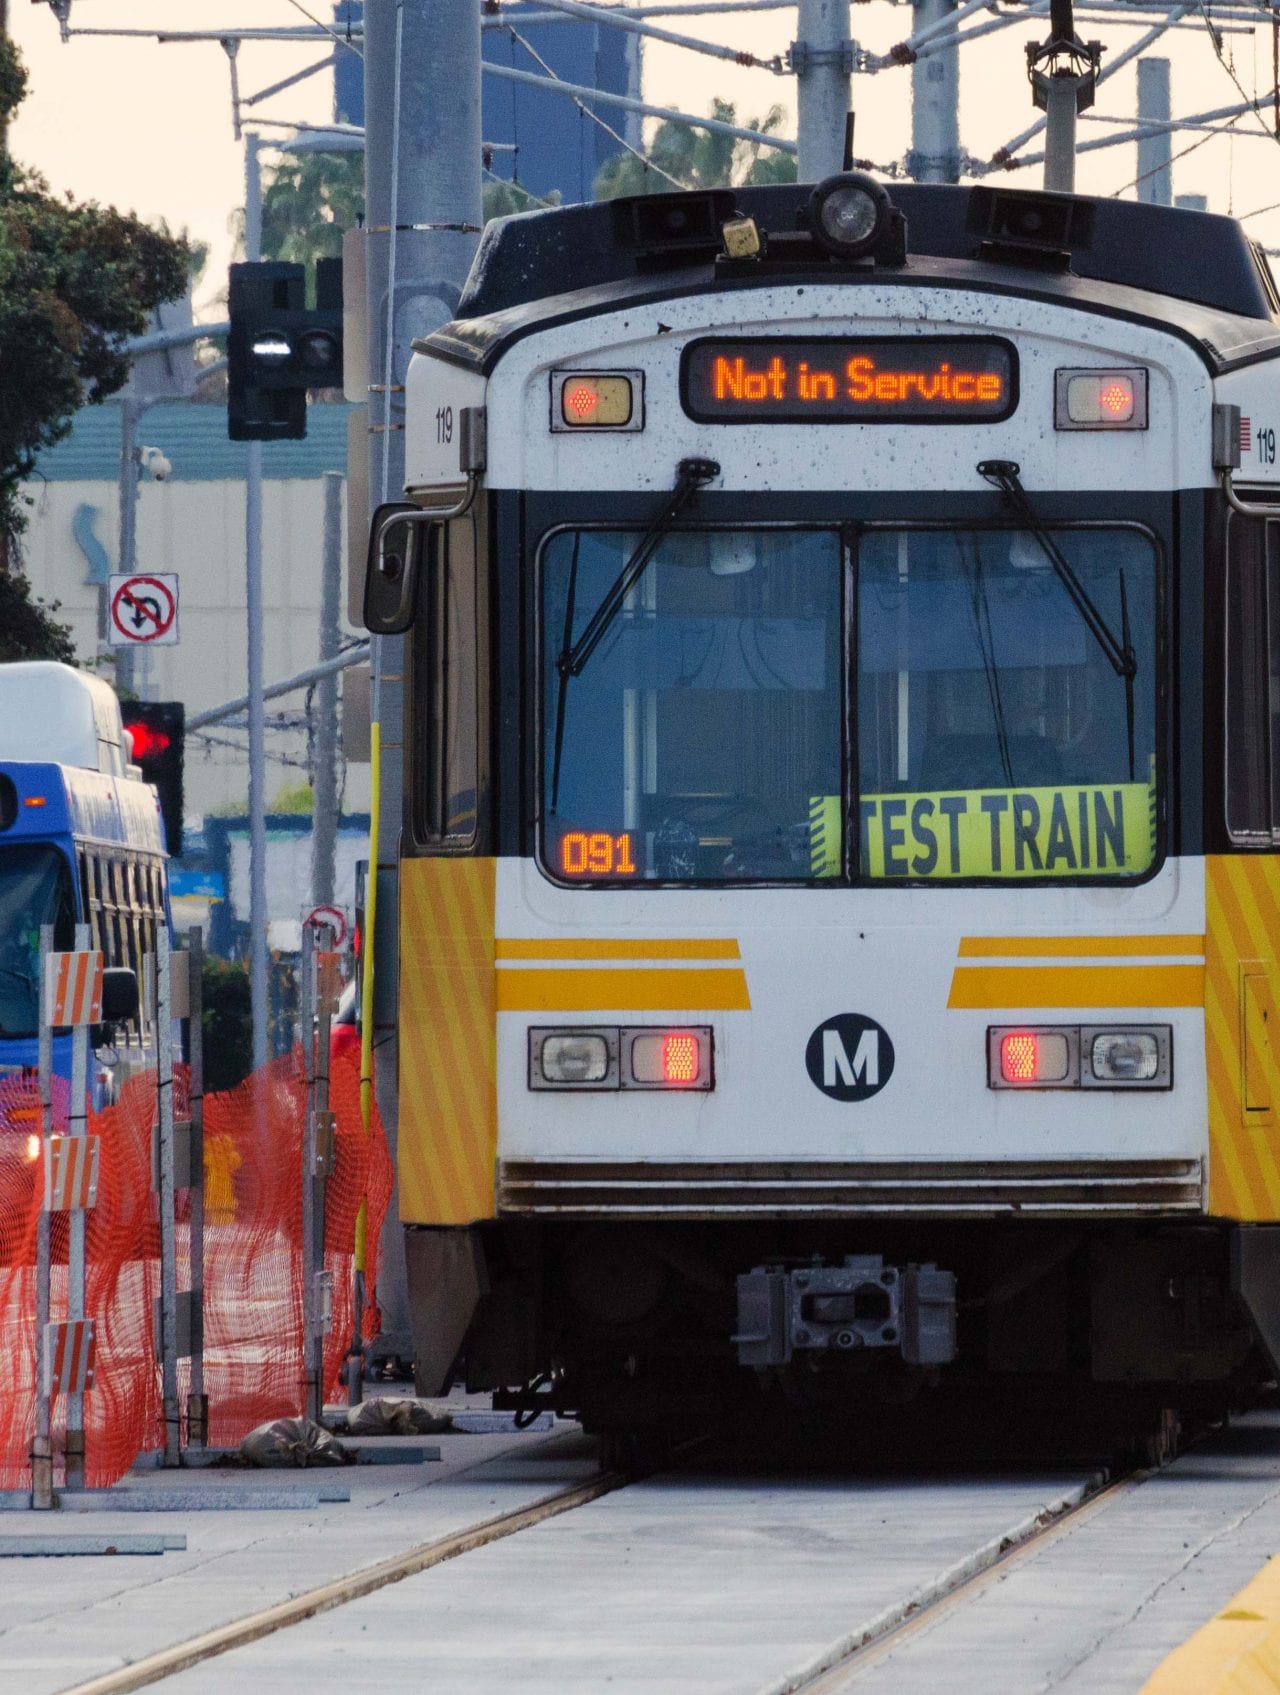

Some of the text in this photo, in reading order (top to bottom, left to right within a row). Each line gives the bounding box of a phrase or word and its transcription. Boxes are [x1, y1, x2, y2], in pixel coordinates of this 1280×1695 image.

[714, 357, 1001, 399] Not in Service
[435, 406, 453, 444] 119
[1256, 427, 1276, 464] 119
[562, 831, 636, 874] 091
[858, 790, 1125, 876] TEST TRAIN
[823, 1029, 879, 1086] M
